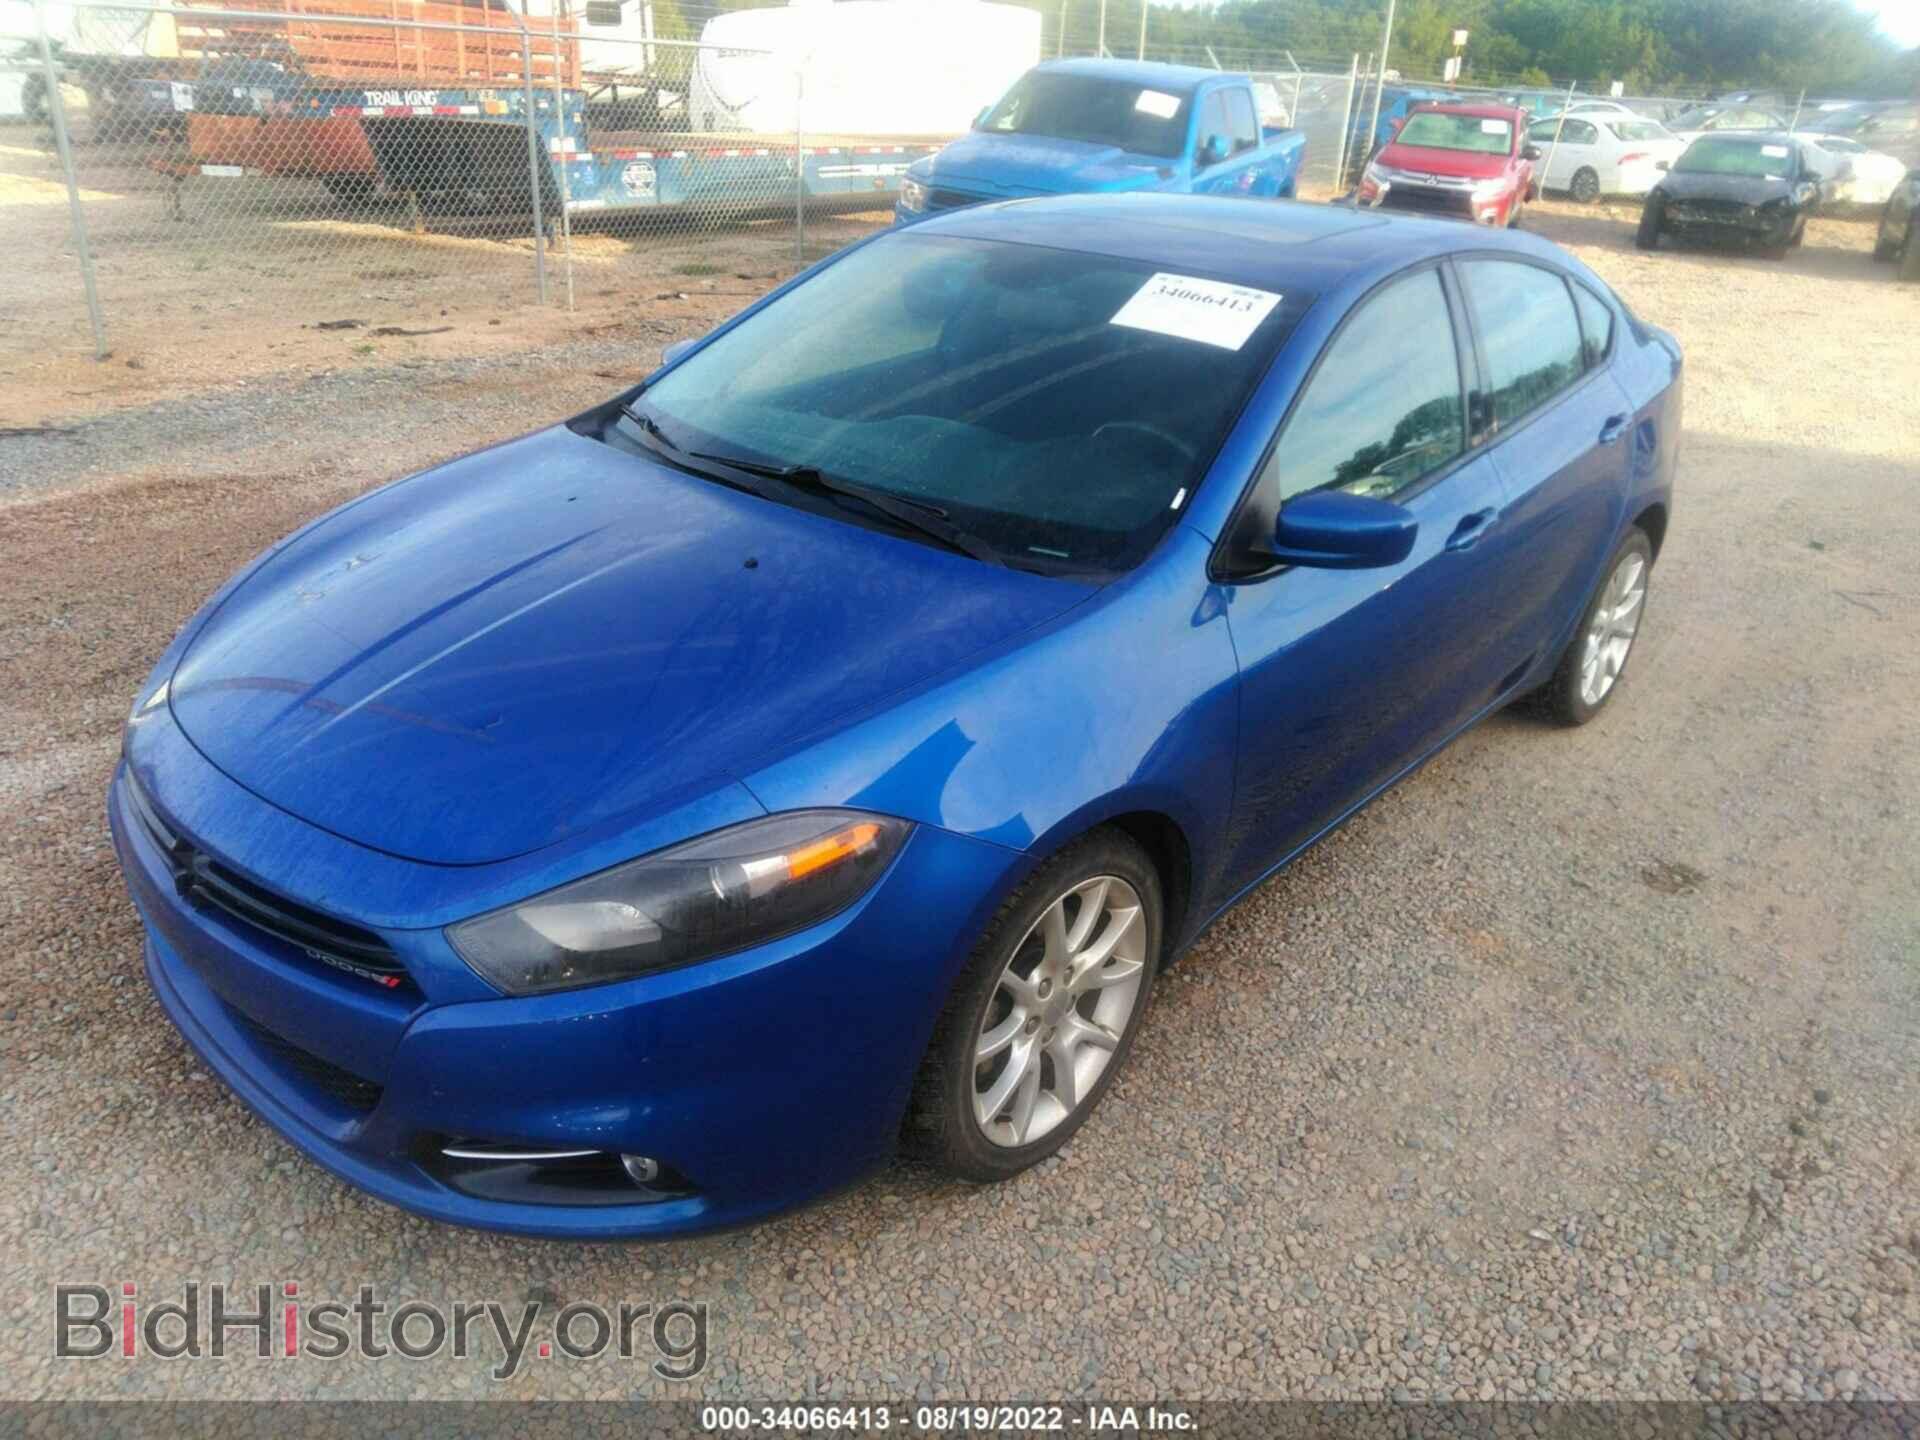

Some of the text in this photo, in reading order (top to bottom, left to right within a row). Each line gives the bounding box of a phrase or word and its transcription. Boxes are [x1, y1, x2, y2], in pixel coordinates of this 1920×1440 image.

[364, 90, 438, 106] TRAIL KING
[1152, 285, 1253, 312] 34066413
